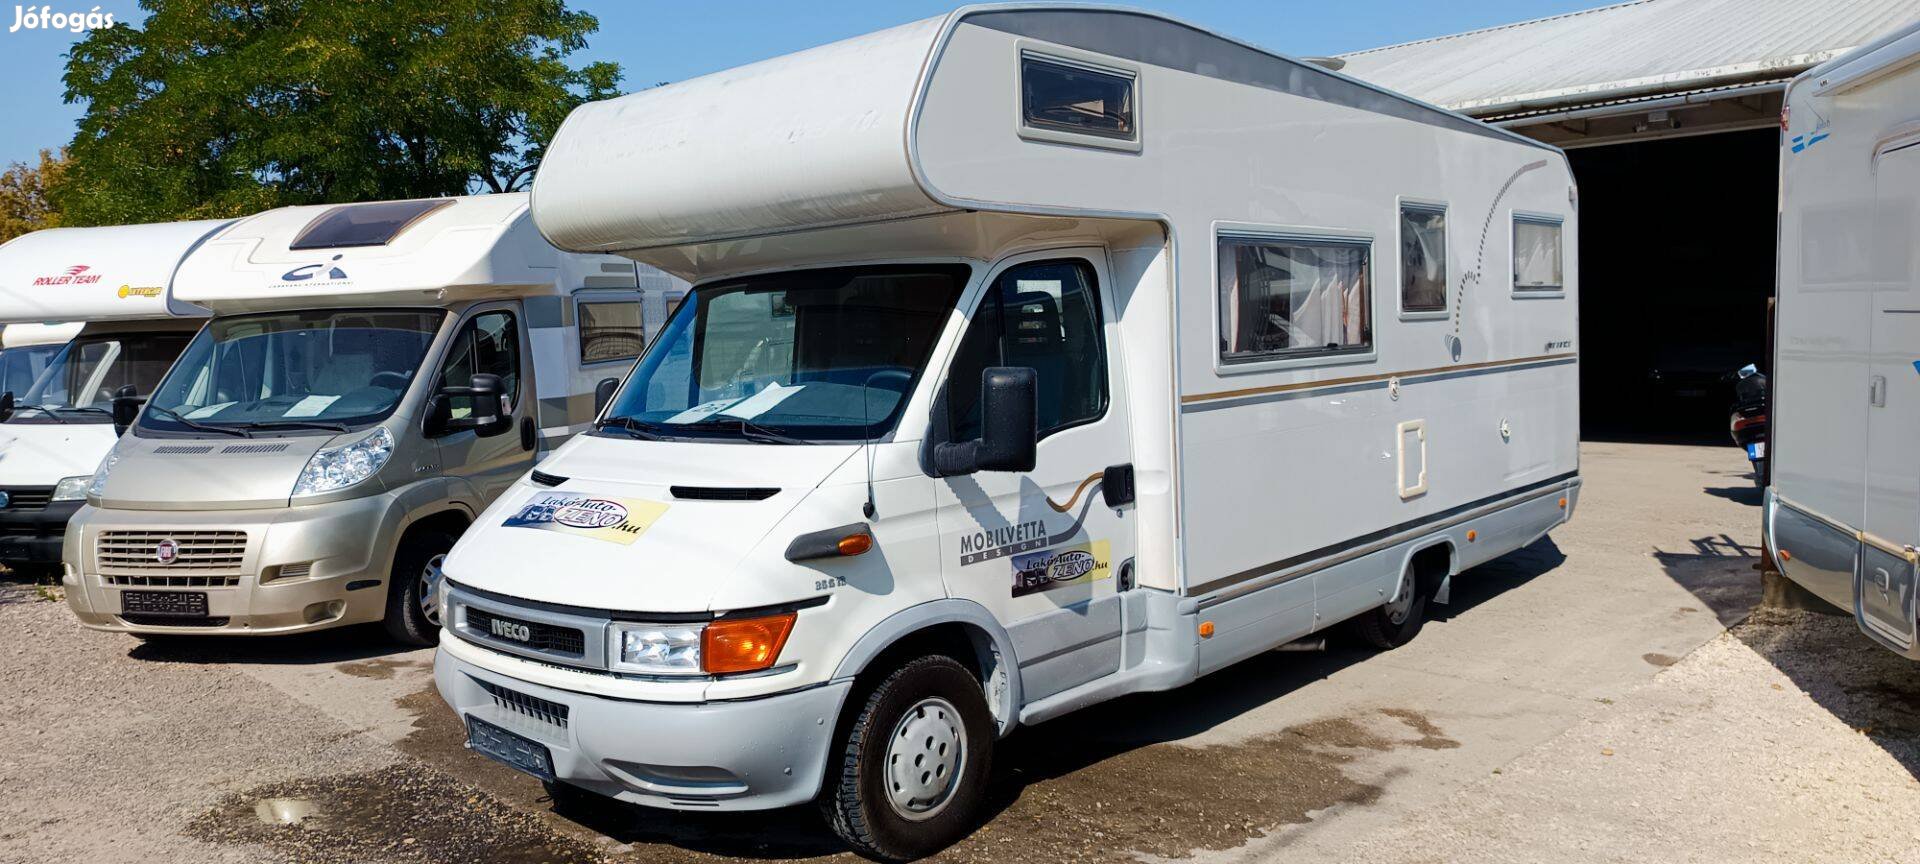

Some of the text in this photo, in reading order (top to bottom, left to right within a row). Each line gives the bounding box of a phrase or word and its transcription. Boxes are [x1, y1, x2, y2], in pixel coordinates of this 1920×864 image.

[33, 274, 102, 286] ROLLER TEAM
[960, 520, 1046, 554] MOBILVETTA
[967, 540, 1042, 563] DESIGN
[490, 618, 530, 642] IVECO
